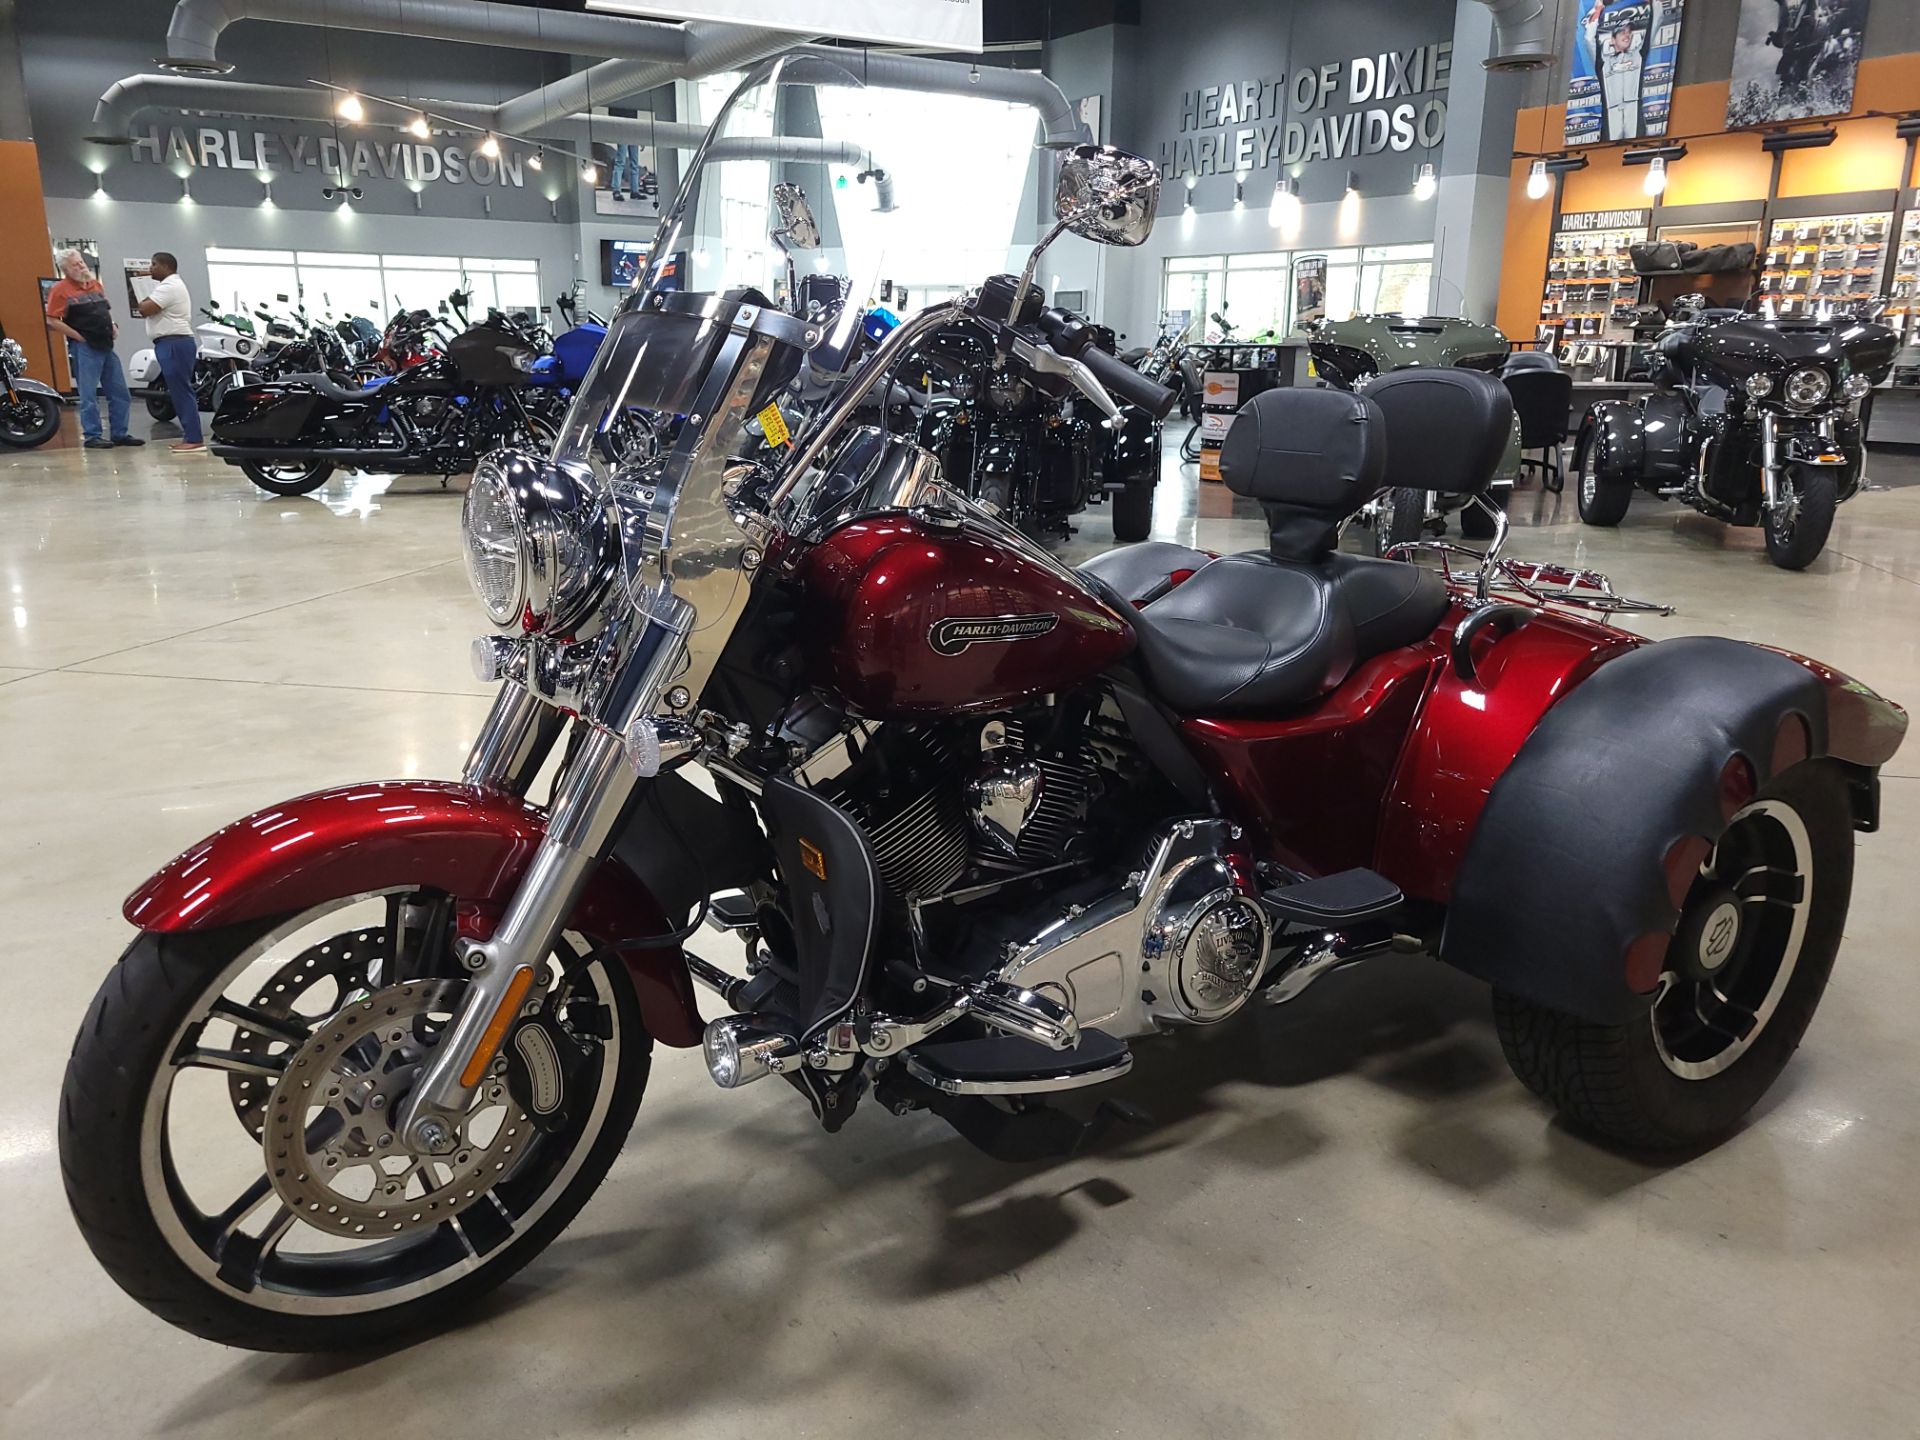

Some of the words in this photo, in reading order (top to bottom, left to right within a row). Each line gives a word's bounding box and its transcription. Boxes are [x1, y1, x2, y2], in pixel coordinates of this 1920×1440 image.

[1179, 73, 1285, 133] HEART
[1293, 62, 1341, 114] OF
[1349, 40, 1453, 105] DIXIE
[128, 125, 524, 188] HARLEY-DAVIDSON
[953, 620, 1052, 636] HARLEY-DAVIDSON
